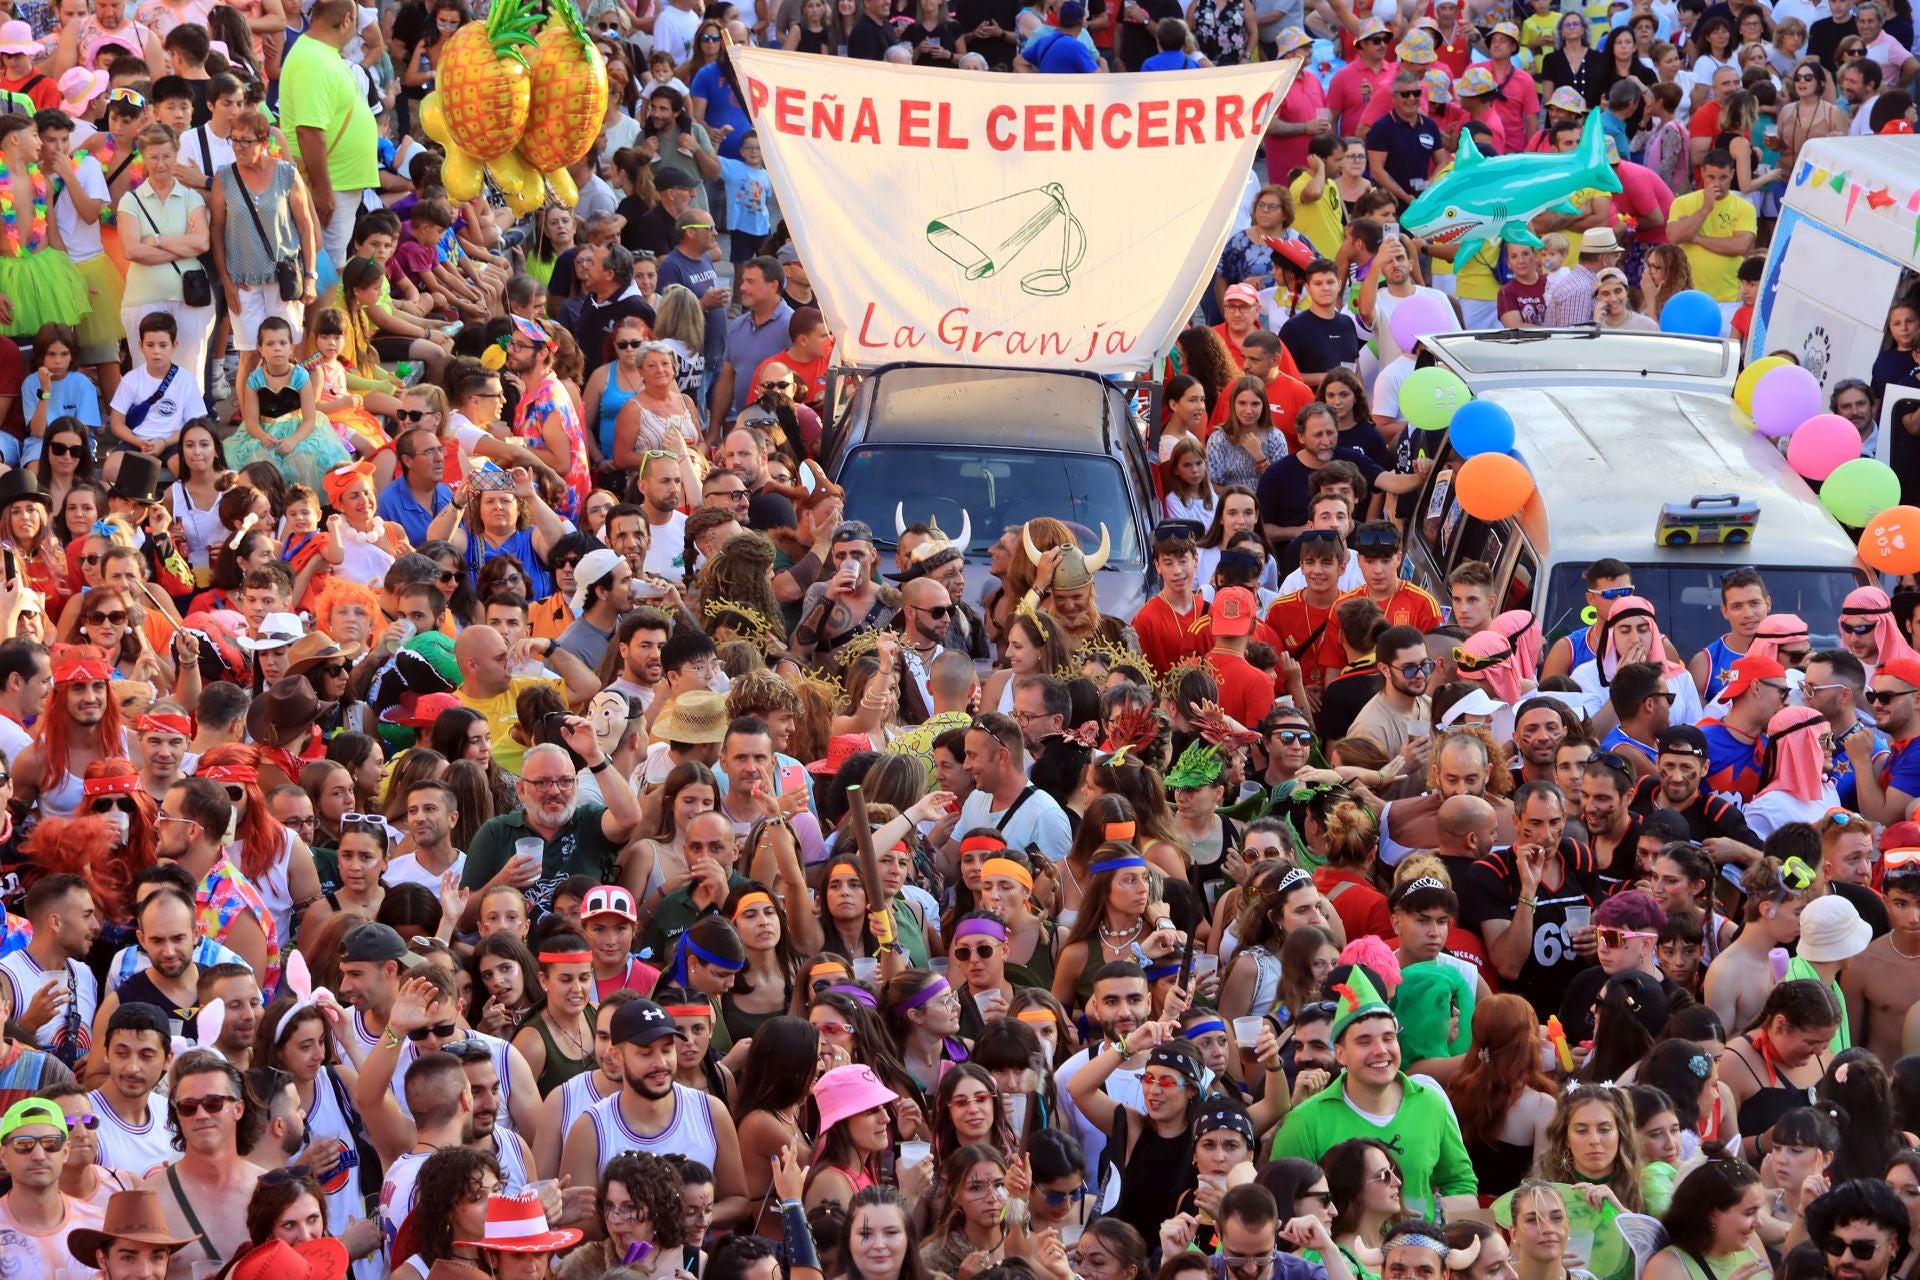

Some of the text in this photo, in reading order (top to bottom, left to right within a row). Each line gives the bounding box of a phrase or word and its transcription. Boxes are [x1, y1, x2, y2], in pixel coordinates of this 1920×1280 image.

[748, 76, 880, 145] PEÑA
[900, 99, 969, 150] EL
[858, 302, 1137, 363] La Granja
[1450, 950, 1483, 966] NCERRO
[1533, 921, 1578, 967] 69
